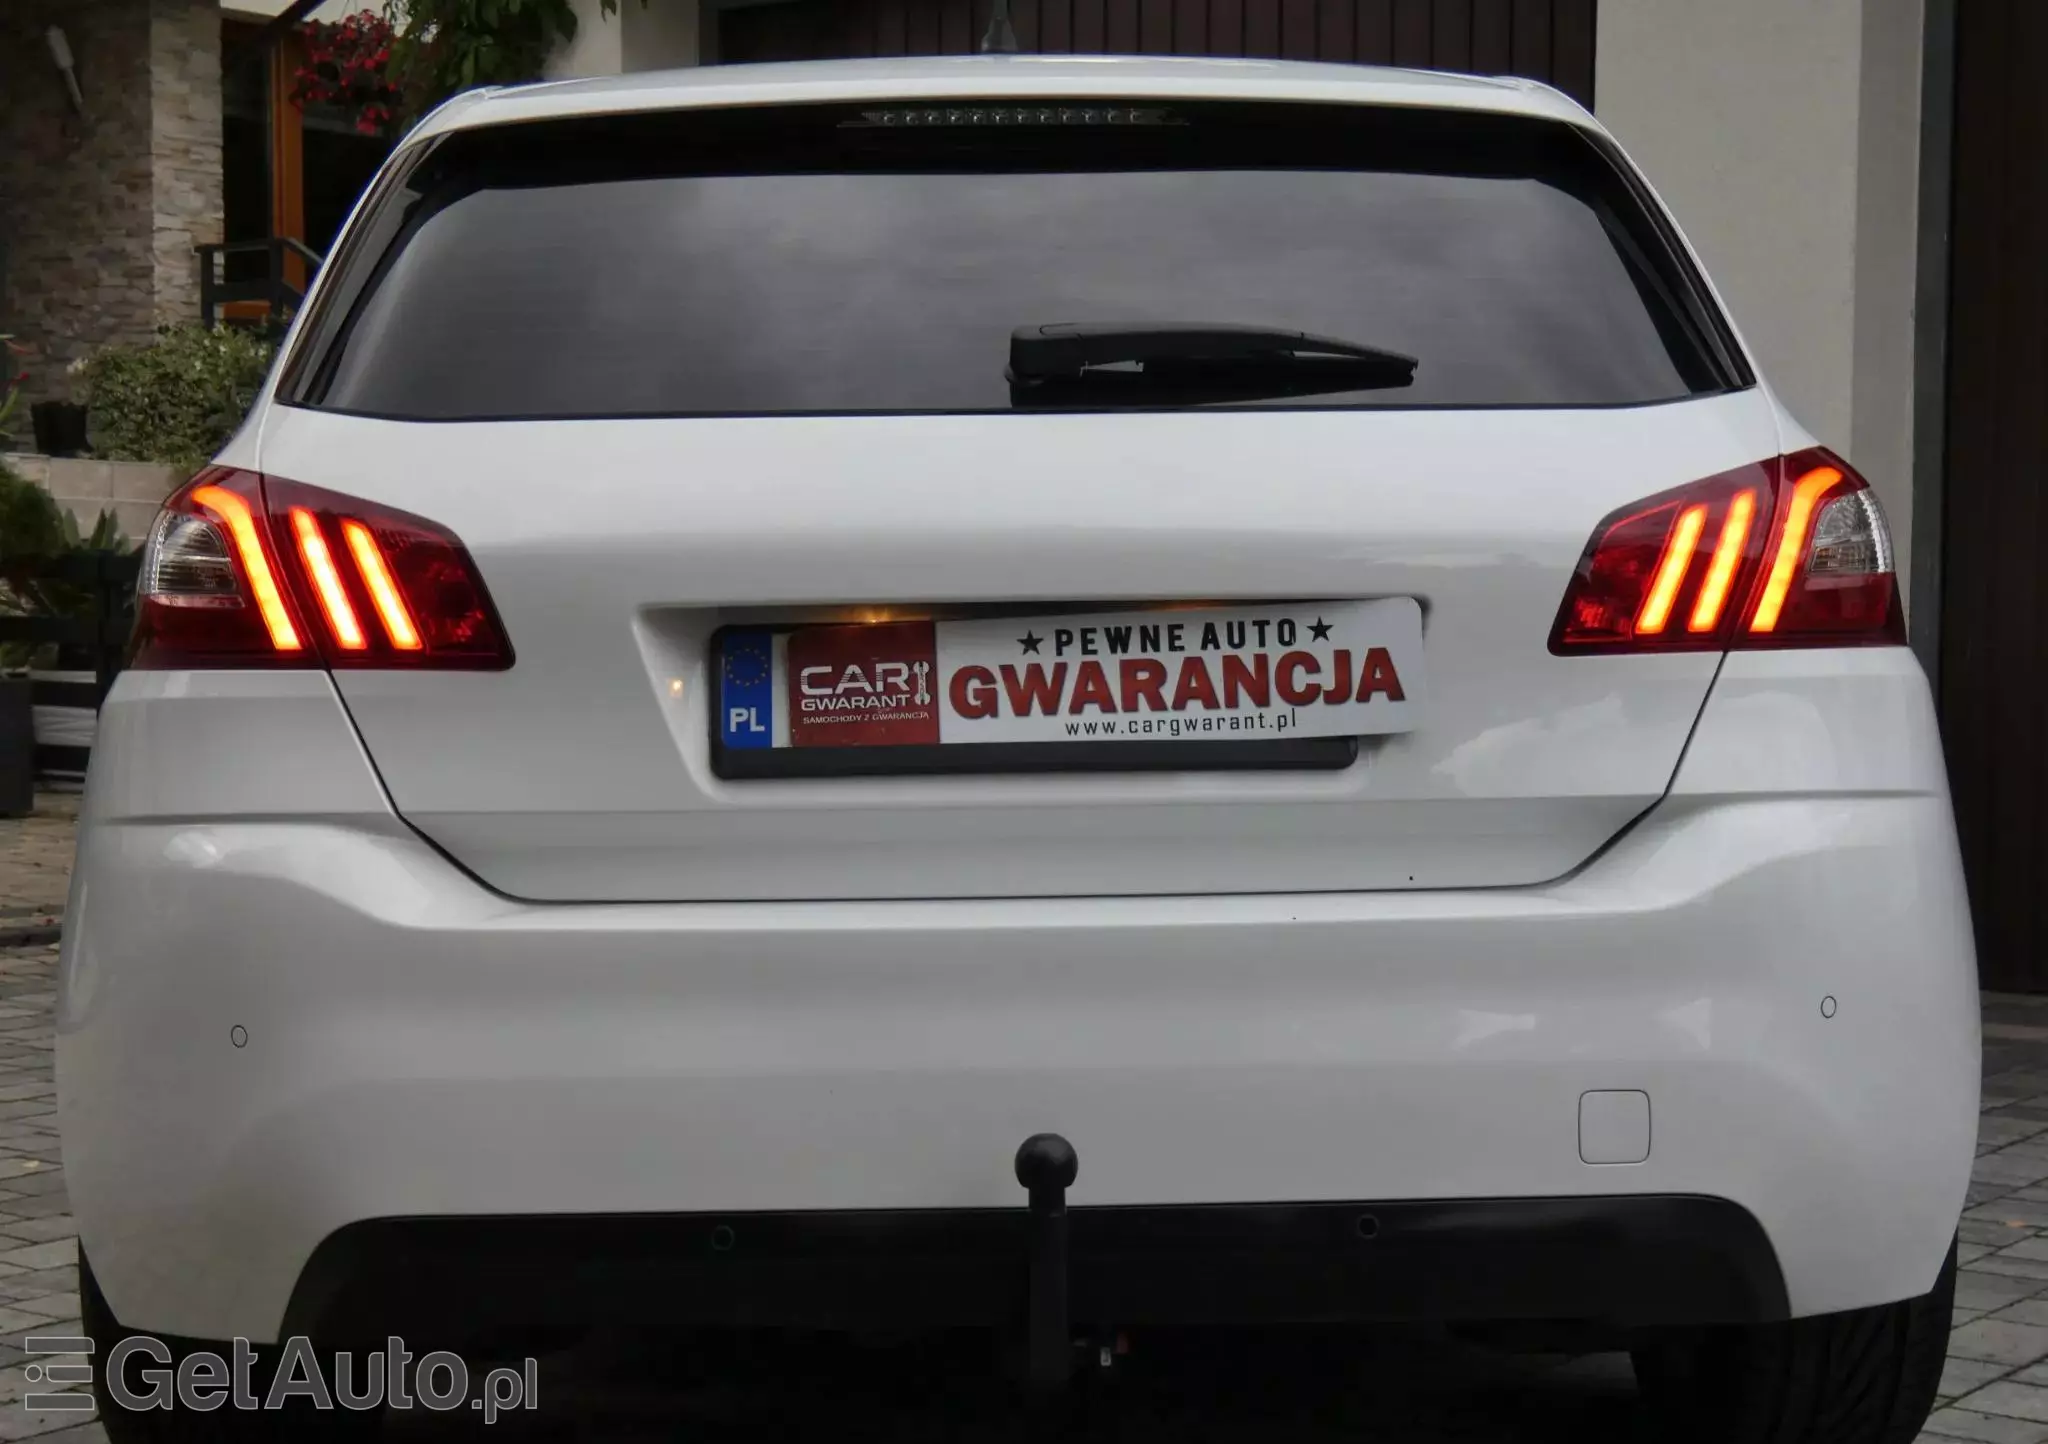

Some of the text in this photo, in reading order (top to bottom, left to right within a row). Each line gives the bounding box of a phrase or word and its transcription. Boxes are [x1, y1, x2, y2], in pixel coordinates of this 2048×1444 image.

[1055, 618, 1297, 656] PEWNE AUTO
[800, 662, 910, 695] CAR
[948, 647, 1406, 719] GWARANCJA
[801, 694, 911, 711] GWARANT
[730, 707, 766, 733] PL
[803, 714, 862, 724] SAMOCHODY
[1065, 708, 1297, 736] www.cargwarant.pl
